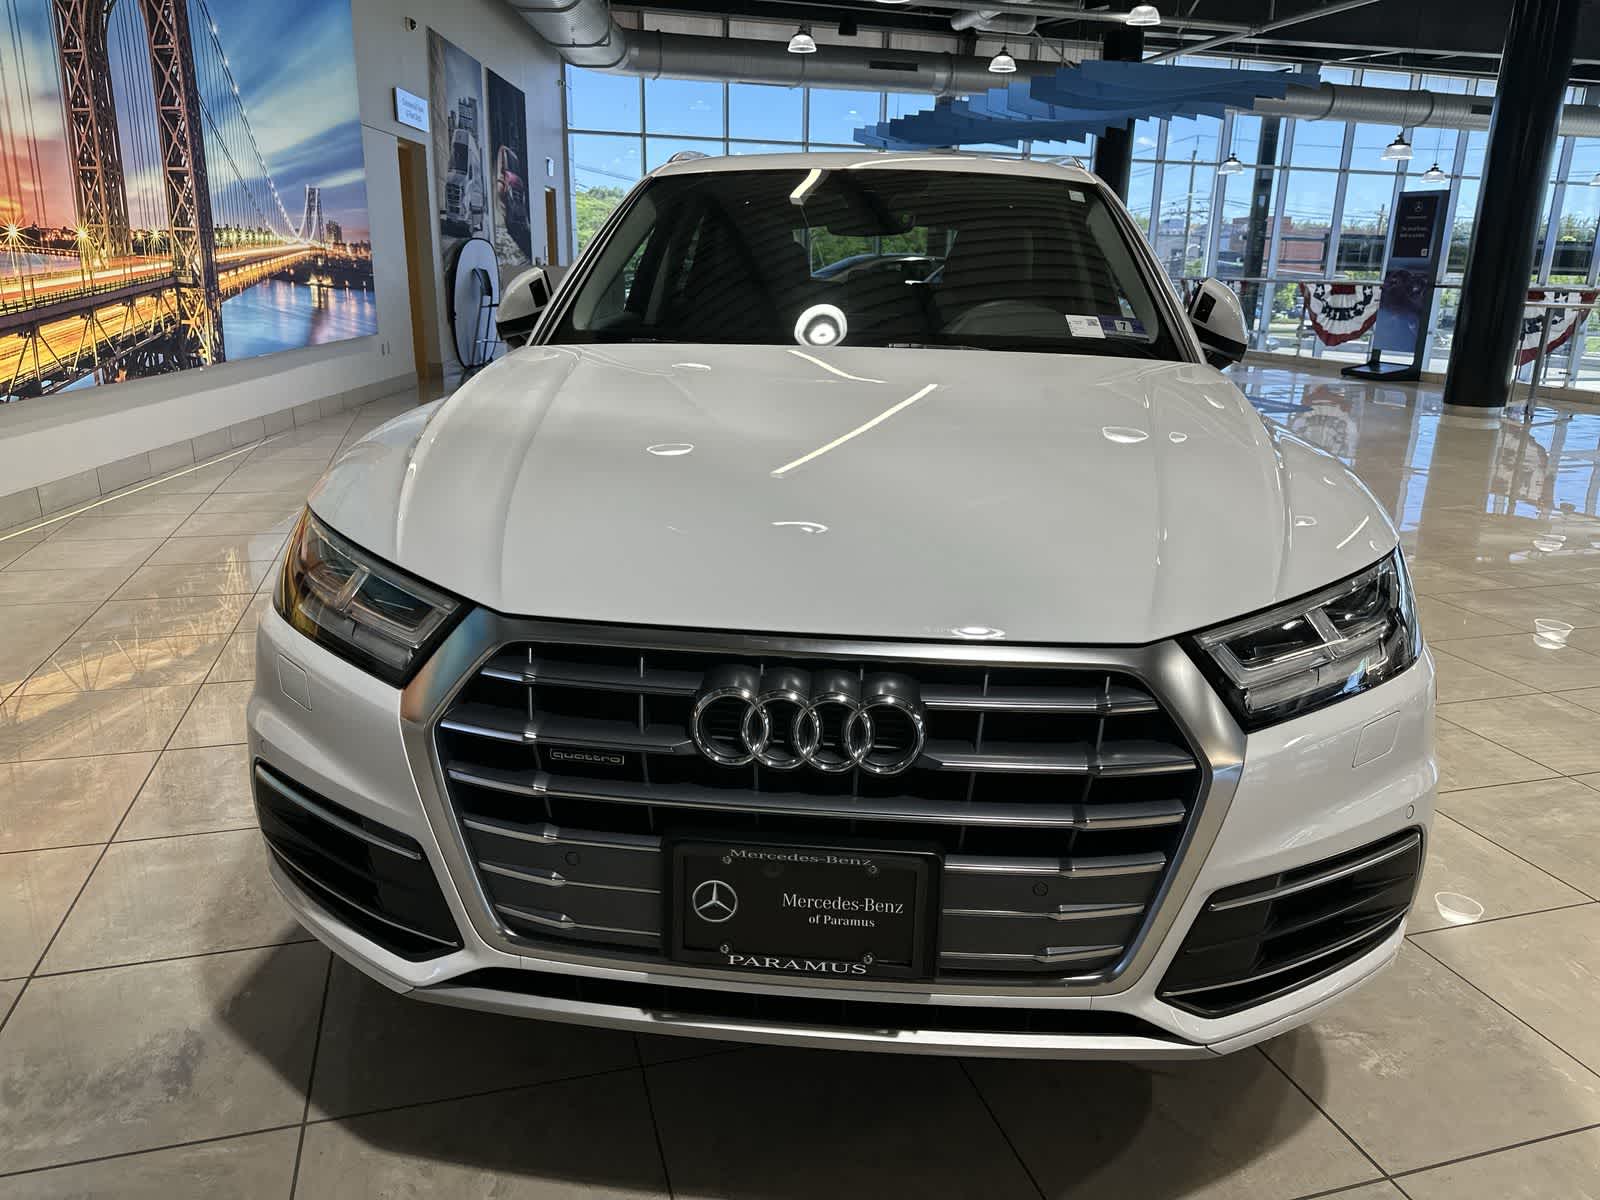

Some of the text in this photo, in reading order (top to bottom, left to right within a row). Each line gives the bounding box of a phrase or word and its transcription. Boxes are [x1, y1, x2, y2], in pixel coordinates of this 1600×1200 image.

[552, 751, 622, 763] quattro
[730, 849, 872, 866] Mercedes-Benz
[782, 892, 904, 914] Mercedes-Benz
[808, 914, 876, 927] of Paramus
[728, 955, 867, 974] PARAMUS
